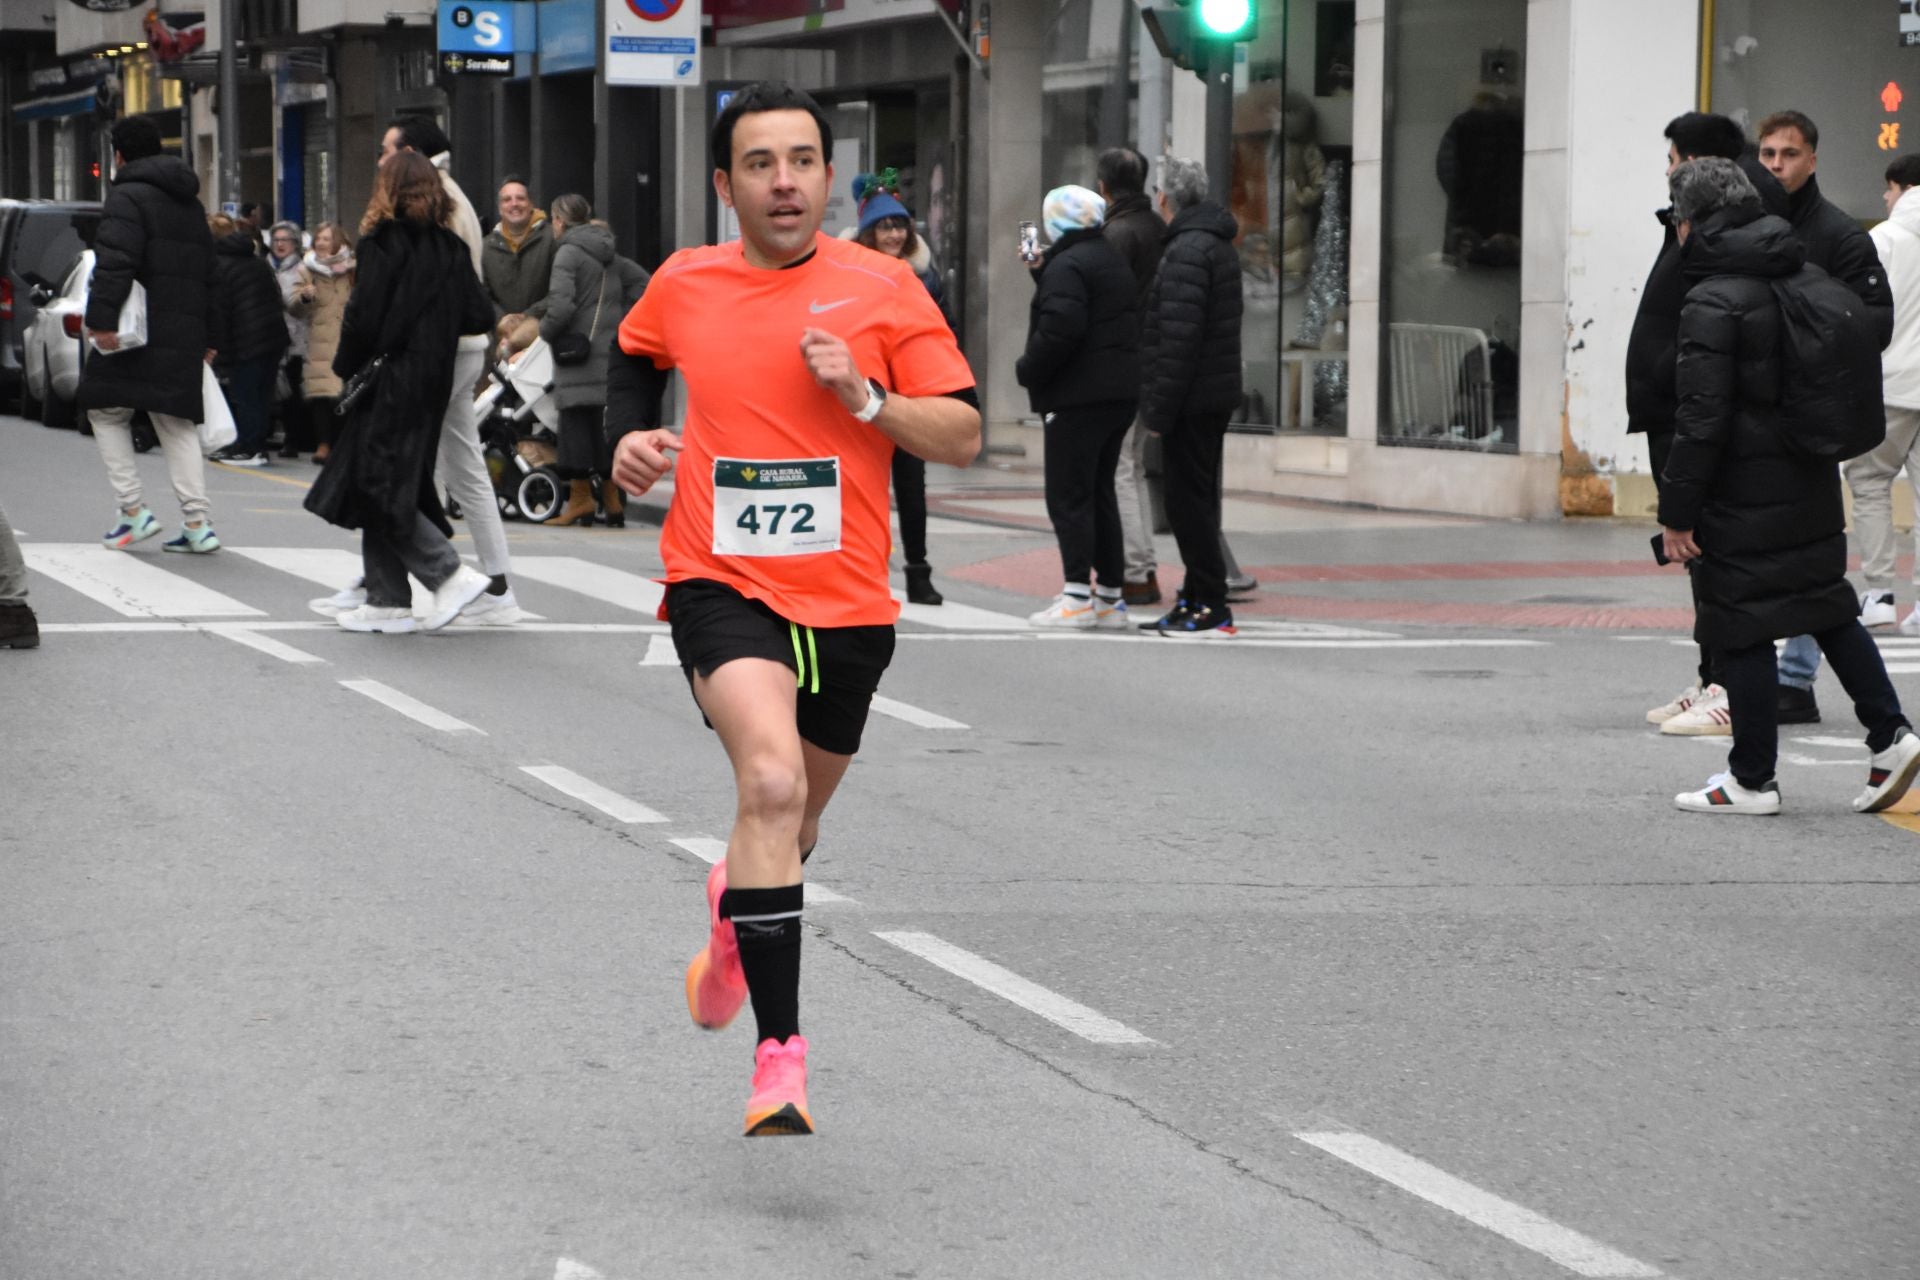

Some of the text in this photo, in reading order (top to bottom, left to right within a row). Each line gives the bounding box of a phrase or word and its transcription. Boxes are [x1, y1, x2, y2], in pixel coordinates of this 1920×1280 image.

[457, 10, 502, 47] B S
[466, 57, 510, 71] ServiRed
[736, 503, 816, 535] 472
